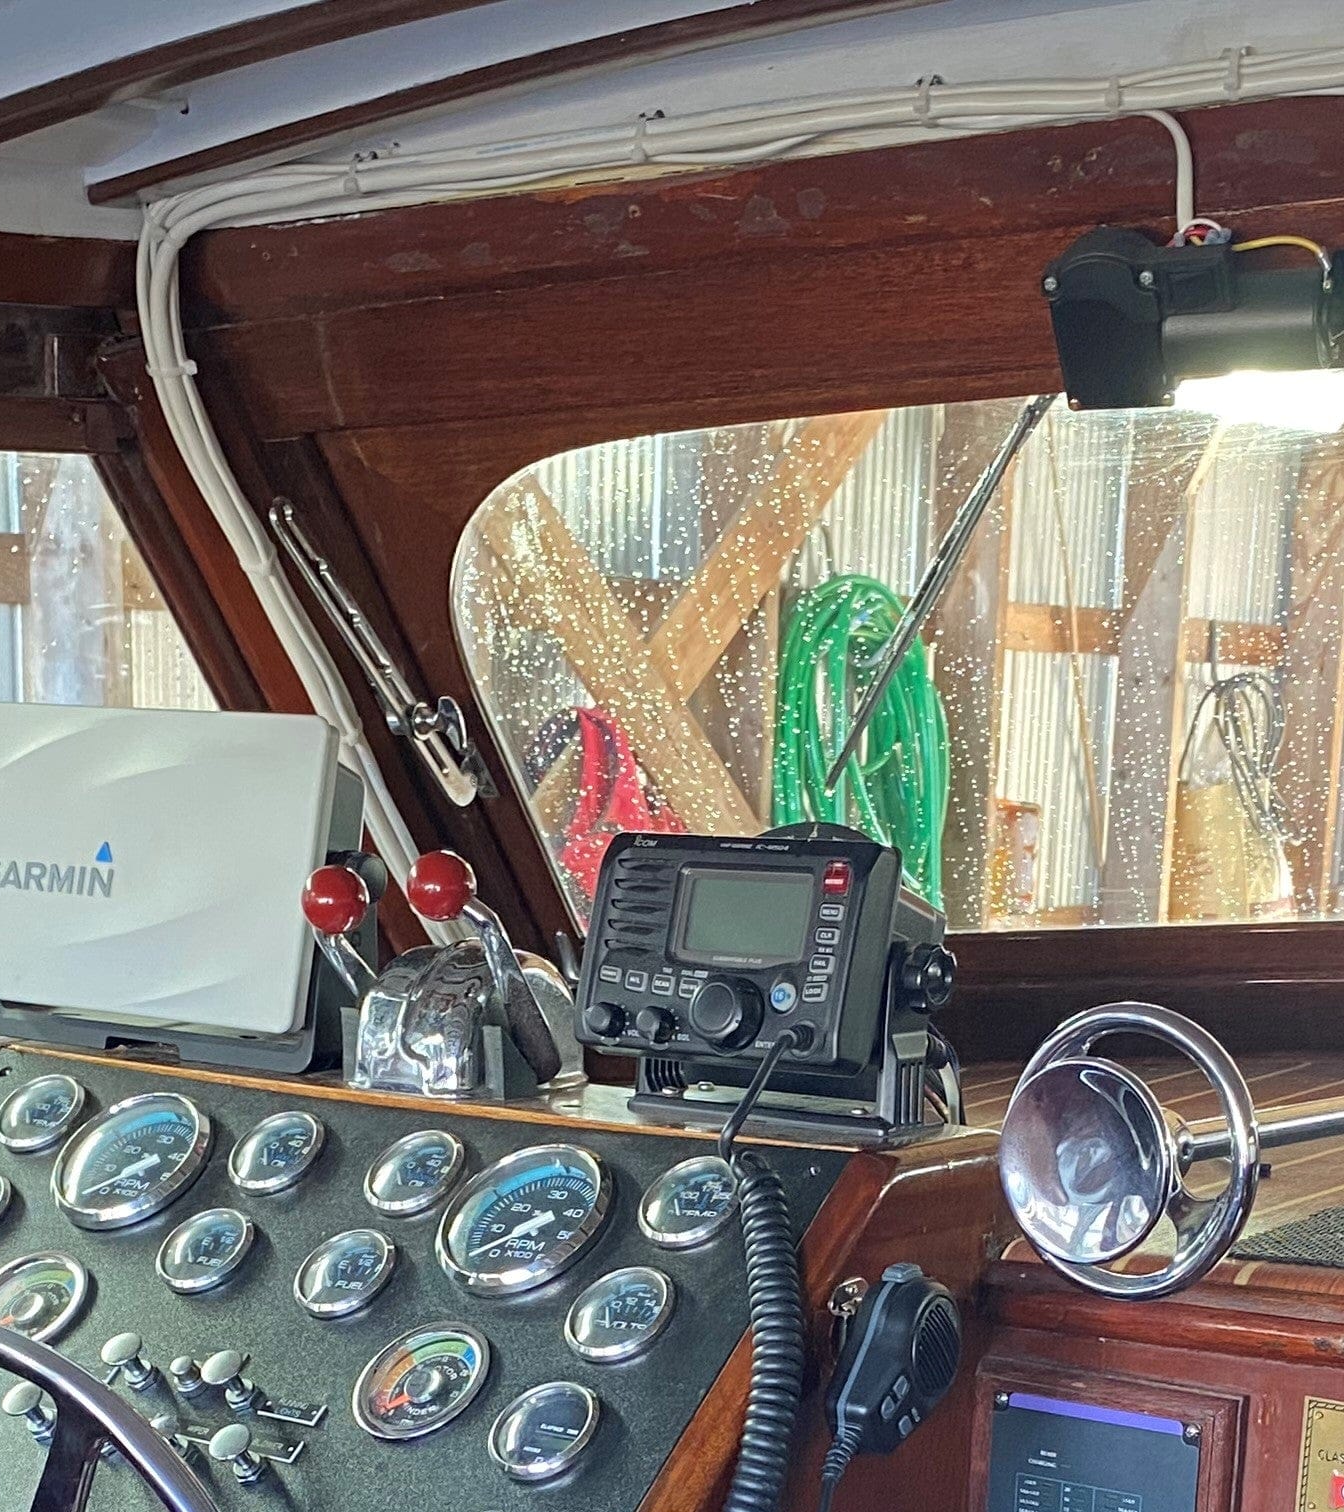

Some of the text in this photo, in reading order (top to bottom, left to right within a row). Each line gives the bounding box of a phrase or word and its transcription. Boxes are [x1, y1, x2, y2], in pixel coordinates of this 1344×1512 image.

[157, 1135, 175, 1144] 30
[114, 1179, 150, 1190] RPM
[547, 1190, 568, 1200] 30
[510, 1203, 532, 1213] 20
[563, 1209, 584, 1218] 40
[490, 1224, 505, 1233] 10
[505, 1240, 546, 1251] RPM
[335, 1280, 363, 1290] FUEL
